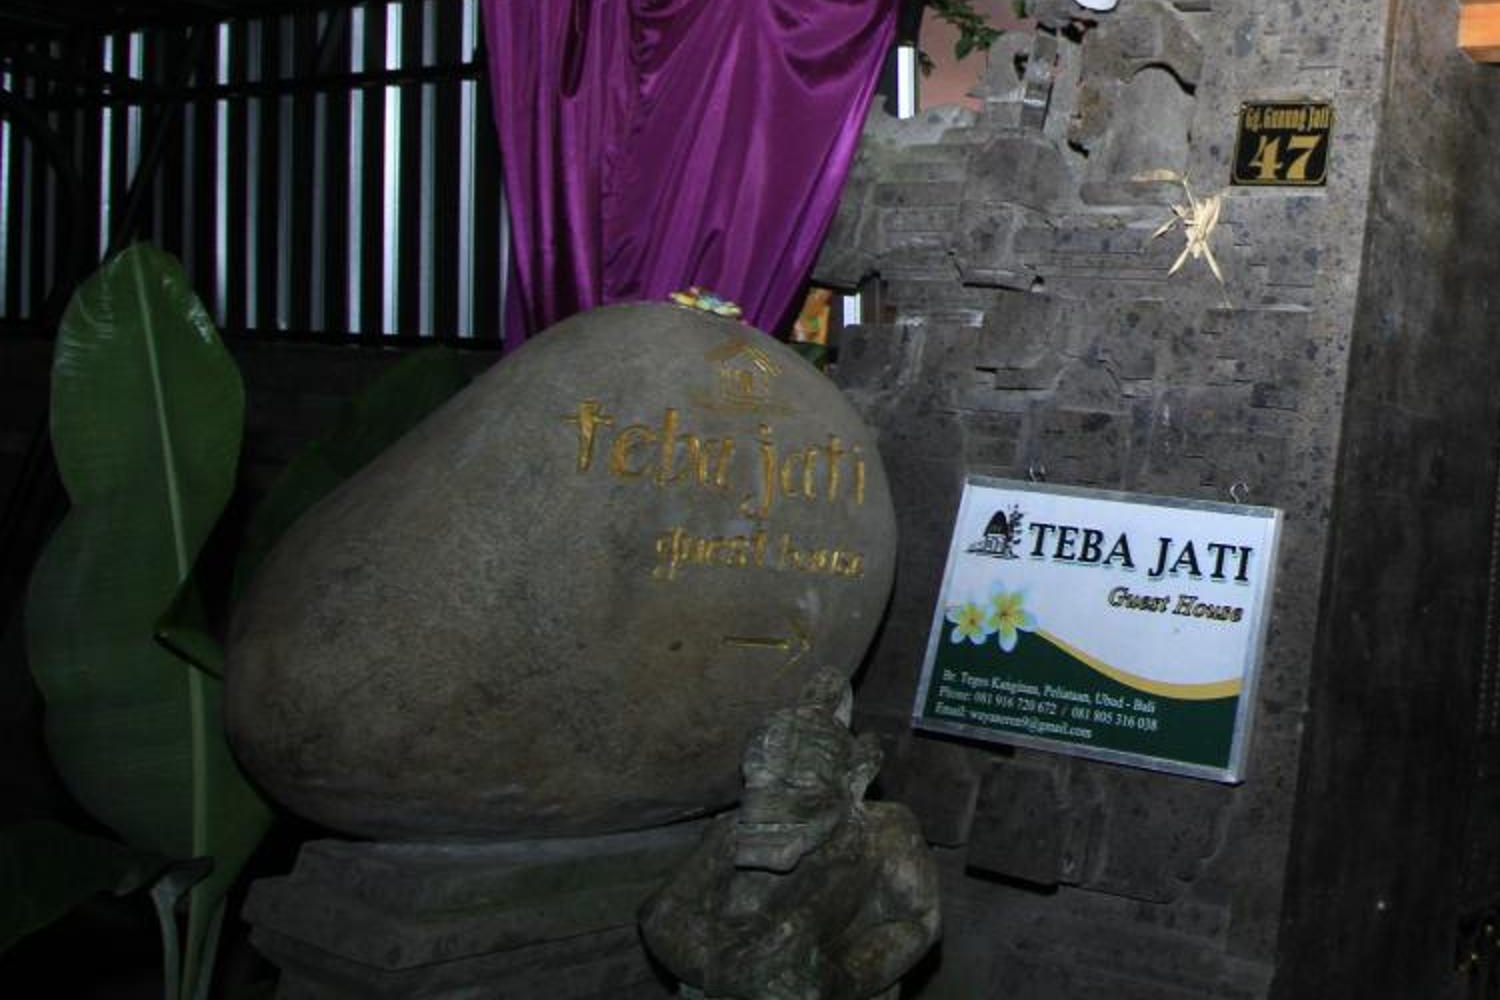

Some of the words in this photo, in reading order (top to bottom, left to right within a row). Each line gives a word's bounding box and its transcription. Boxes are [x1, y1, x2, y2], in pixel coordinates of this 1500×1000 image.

[1248, 134, 1322, 180] 47
[1029, 522, 1136, 570] TEBA
[1148, 537, 1253, 583] JATI
[1108, 586, 1170, 613] Guest
[1172, 594, 1244, 623] House
